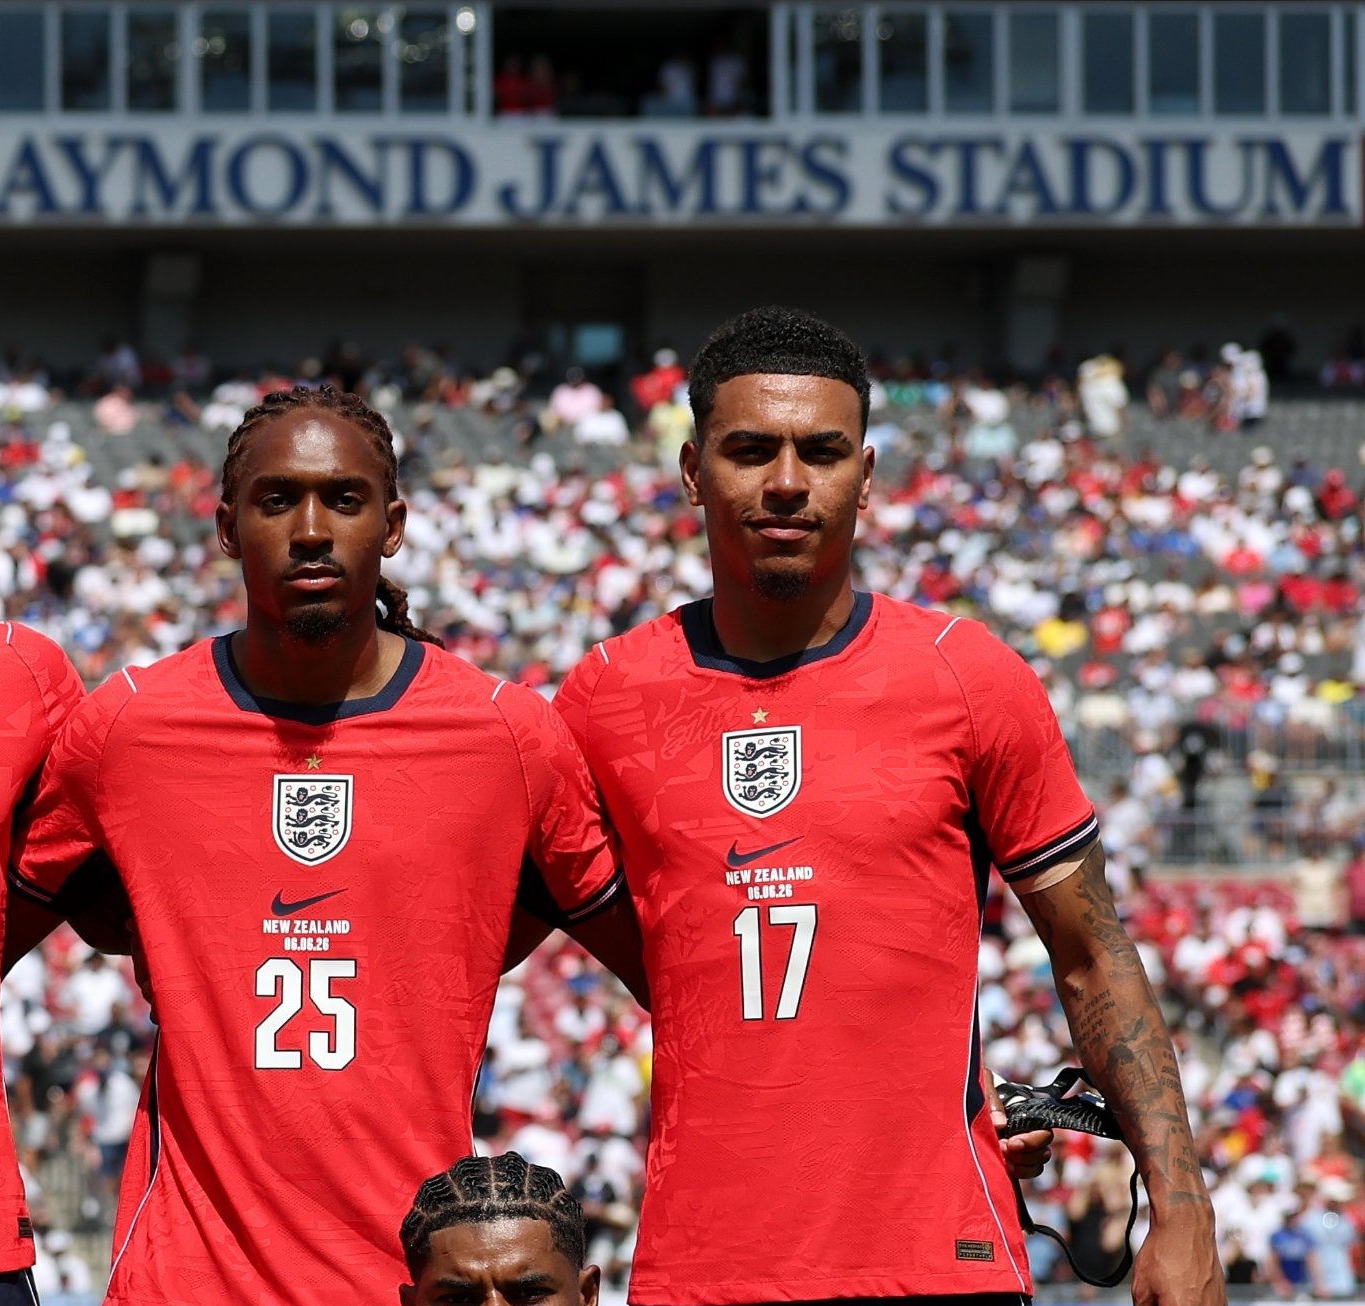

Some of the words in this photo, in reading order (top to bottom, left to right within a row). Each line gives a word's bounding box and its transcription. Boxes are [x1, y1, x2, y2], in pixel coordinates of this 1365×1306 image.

[496, 134, 850, 224] JAMES
[883, 134, 1357, 220] STADIUM
[725, 869, 752, 886] NEW
[754, 866, 813, 883] ZEALAND
[747, 884, 793, 900] 06.06.26
[263, 919, 292, 934] NEW
[293, 919, 350, 934] ZEALAND
[284, 937, 329, 951] 06.06.26
[733, 904, 818, 1021] 17
[255, 957, 357, 1071] 25
